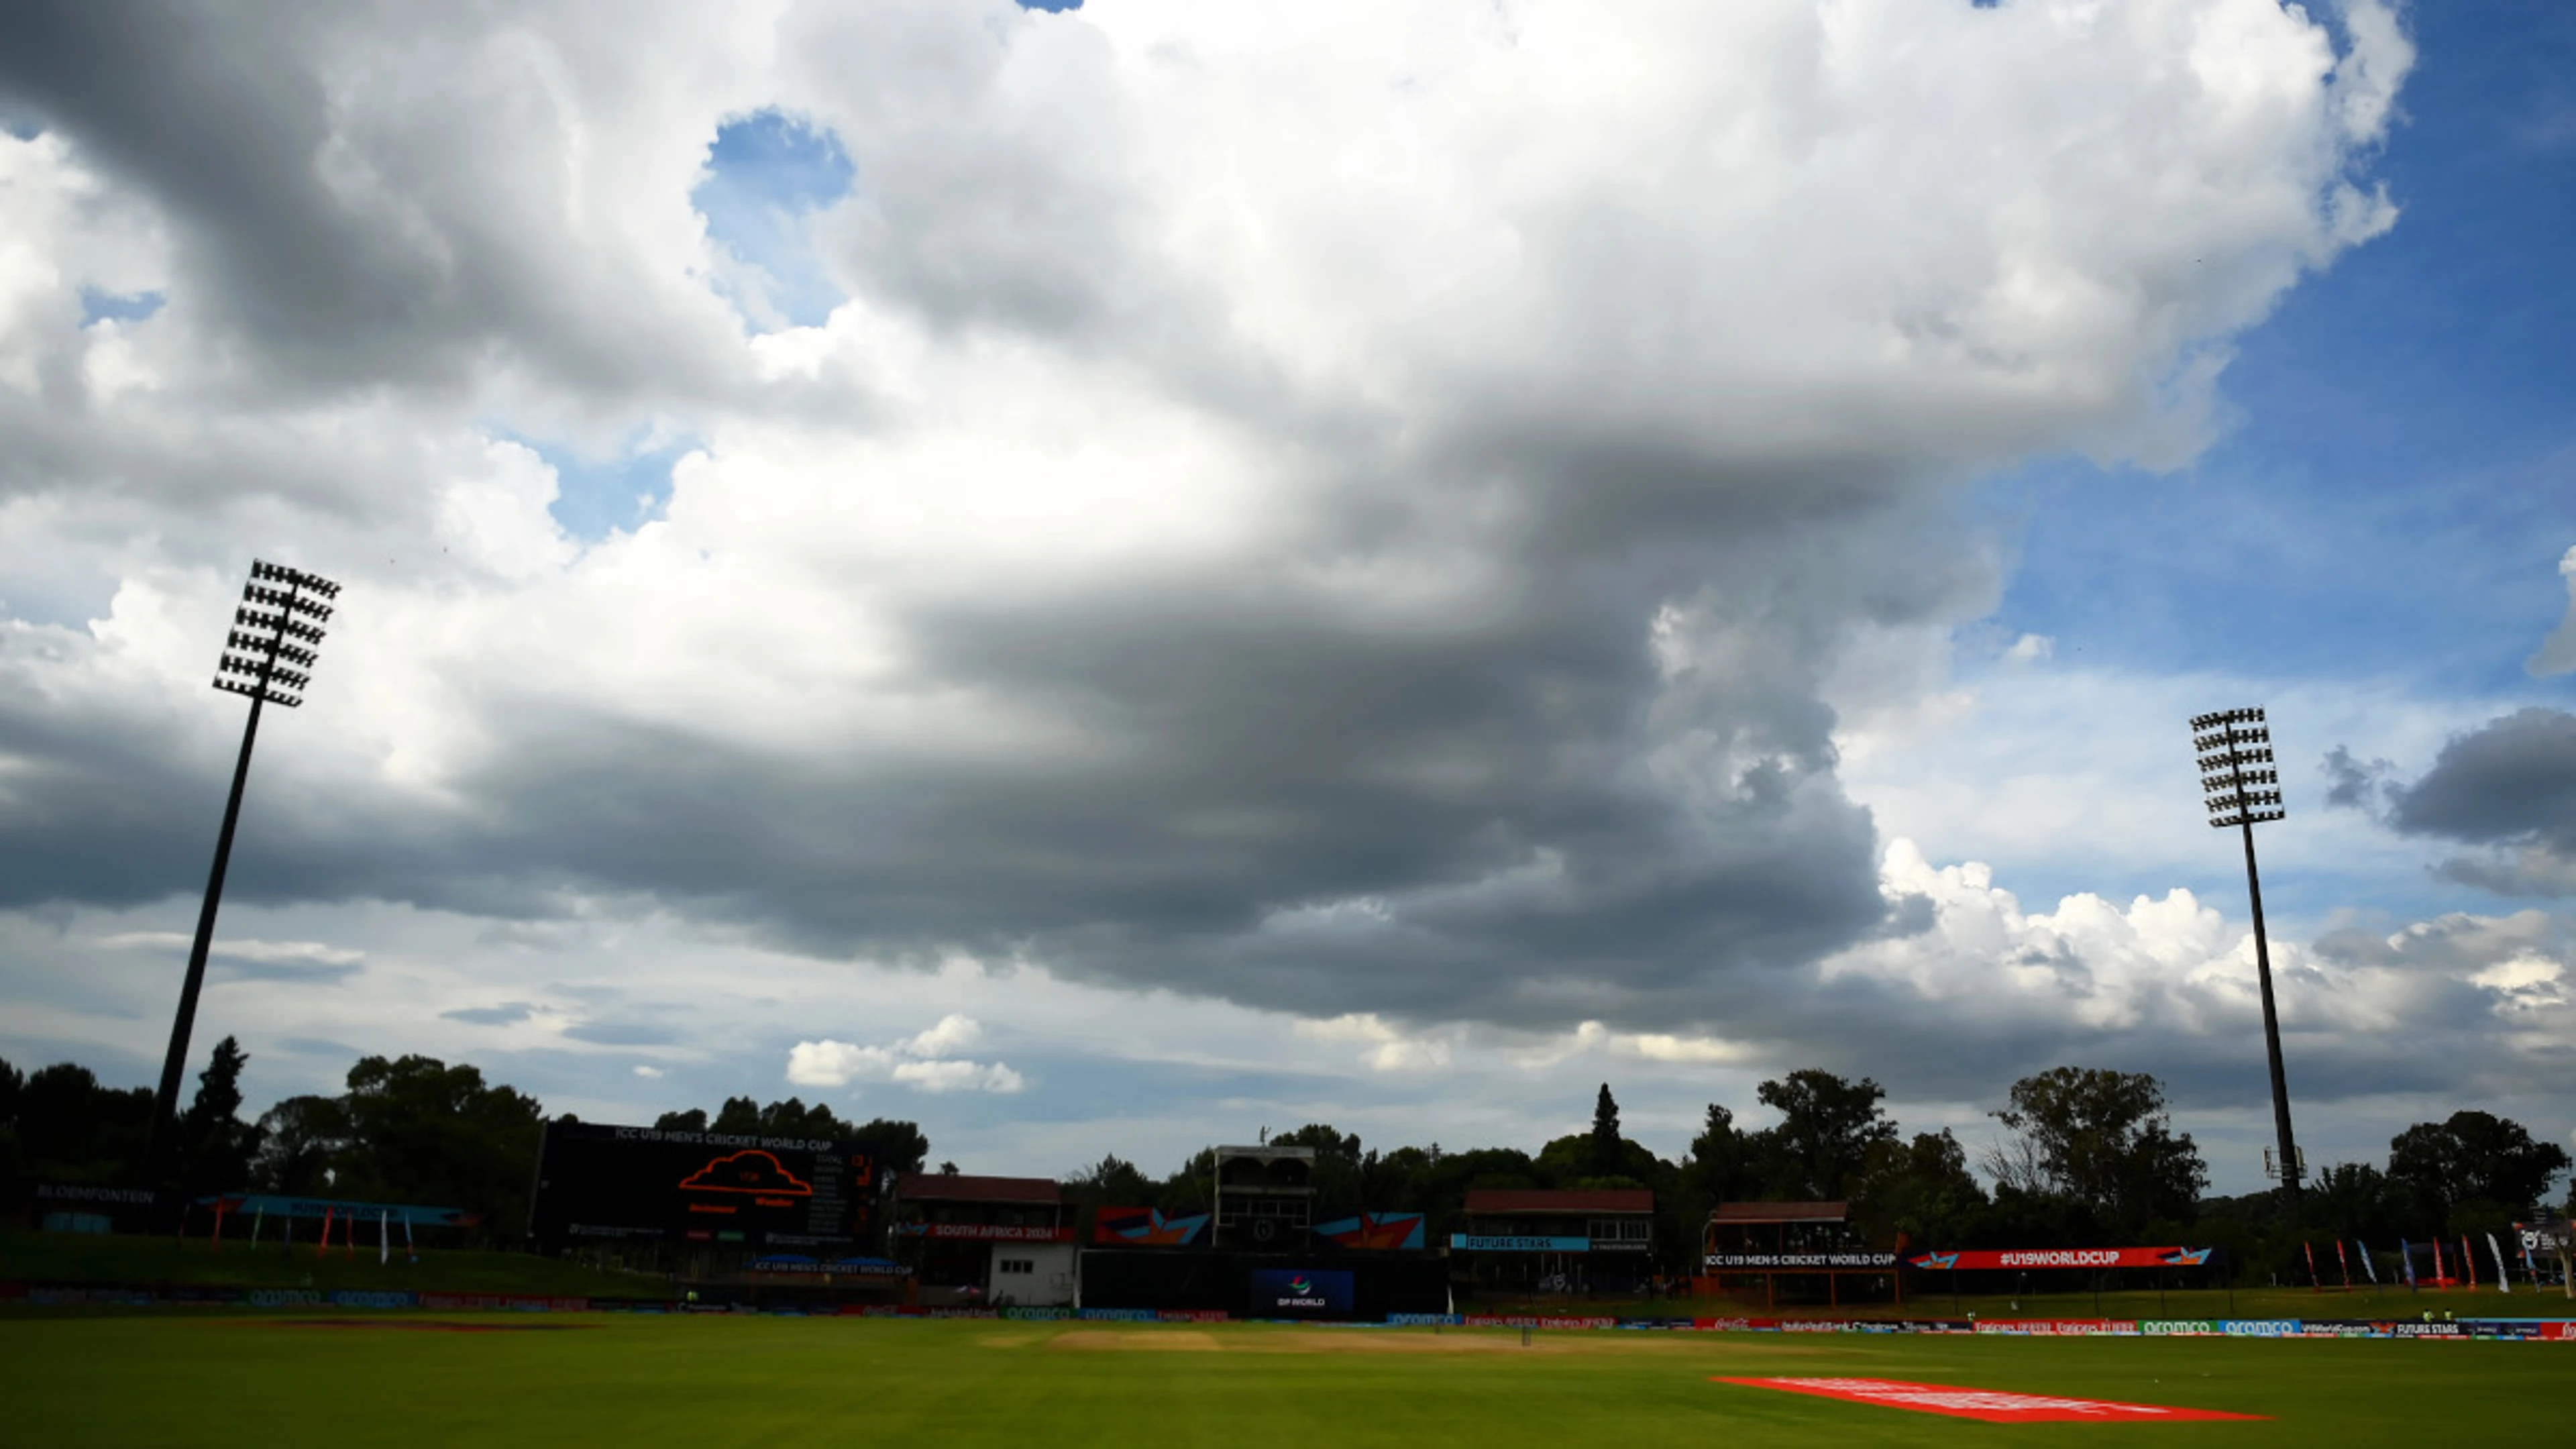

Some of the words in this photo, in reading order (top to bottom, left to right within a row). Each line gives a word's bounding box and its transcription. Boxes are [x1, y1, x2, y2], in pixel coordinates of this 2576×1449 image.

[615, 1128, 638, 1139] ICC
[641, 1129, 662, 1141] U19
[665, 1130, 702, 1143] MEN'S
[705, 1133, 757, 1148] CRICKET
[761, 1136, 805, 1150] WORLD
[808, 1138, 834, 1152] CUP
[38, 1183, 156, 1204] BLOEMFONTEIN
[935, 1224, 977, 1237] SOUTH
[979, 1225, 1022, 1238] AFRICA
[1025, 1227, 1053, 1239] 2024
[1469, 1238, 1514, 1248] FUTURE
[1516, 1238, 1551, 1248] STARS
[1706, 1254, 1725, 1265] ICC
[1725, 1254, 1745, 1265] U19
[1746, 1254, 1780, 1266] MEN'S
[1780, 1254, 1827, 1266] CRICKET
[1828, 1254, 1870, 1265] WORLD
[1872, 1253, 1896, 1265] CUP
[2000, 1251, 2120, 1265] #U19WORLDCUP
[755, 1263, 771, 1271] ICC
[772, 1263, 788, 1272] U19
[819, 1265, 858, 1273] CRICKET
[859, 1266, 894, 1275] WORLD
[894, 1267, 914, 1275] CUP
[249, 1288, 321, 1306] aramco
[336, 1291, 409, 1307] aramco
[1291, 1297, 1326, 1306] WORLD
[1006, 1307, 1071, 1319] aramco
[1085, 1309, 1147, 1320] aramco
[1392, 1313, 1456, 1325] aramco
[2143, 1322, 2210, 1333] aramco
[2226, 1322, 2293, 1334] aramco
[2397, 1324, 2430, 1334] FUTURE
[2431, 1324, 2459, 1334] STARS
